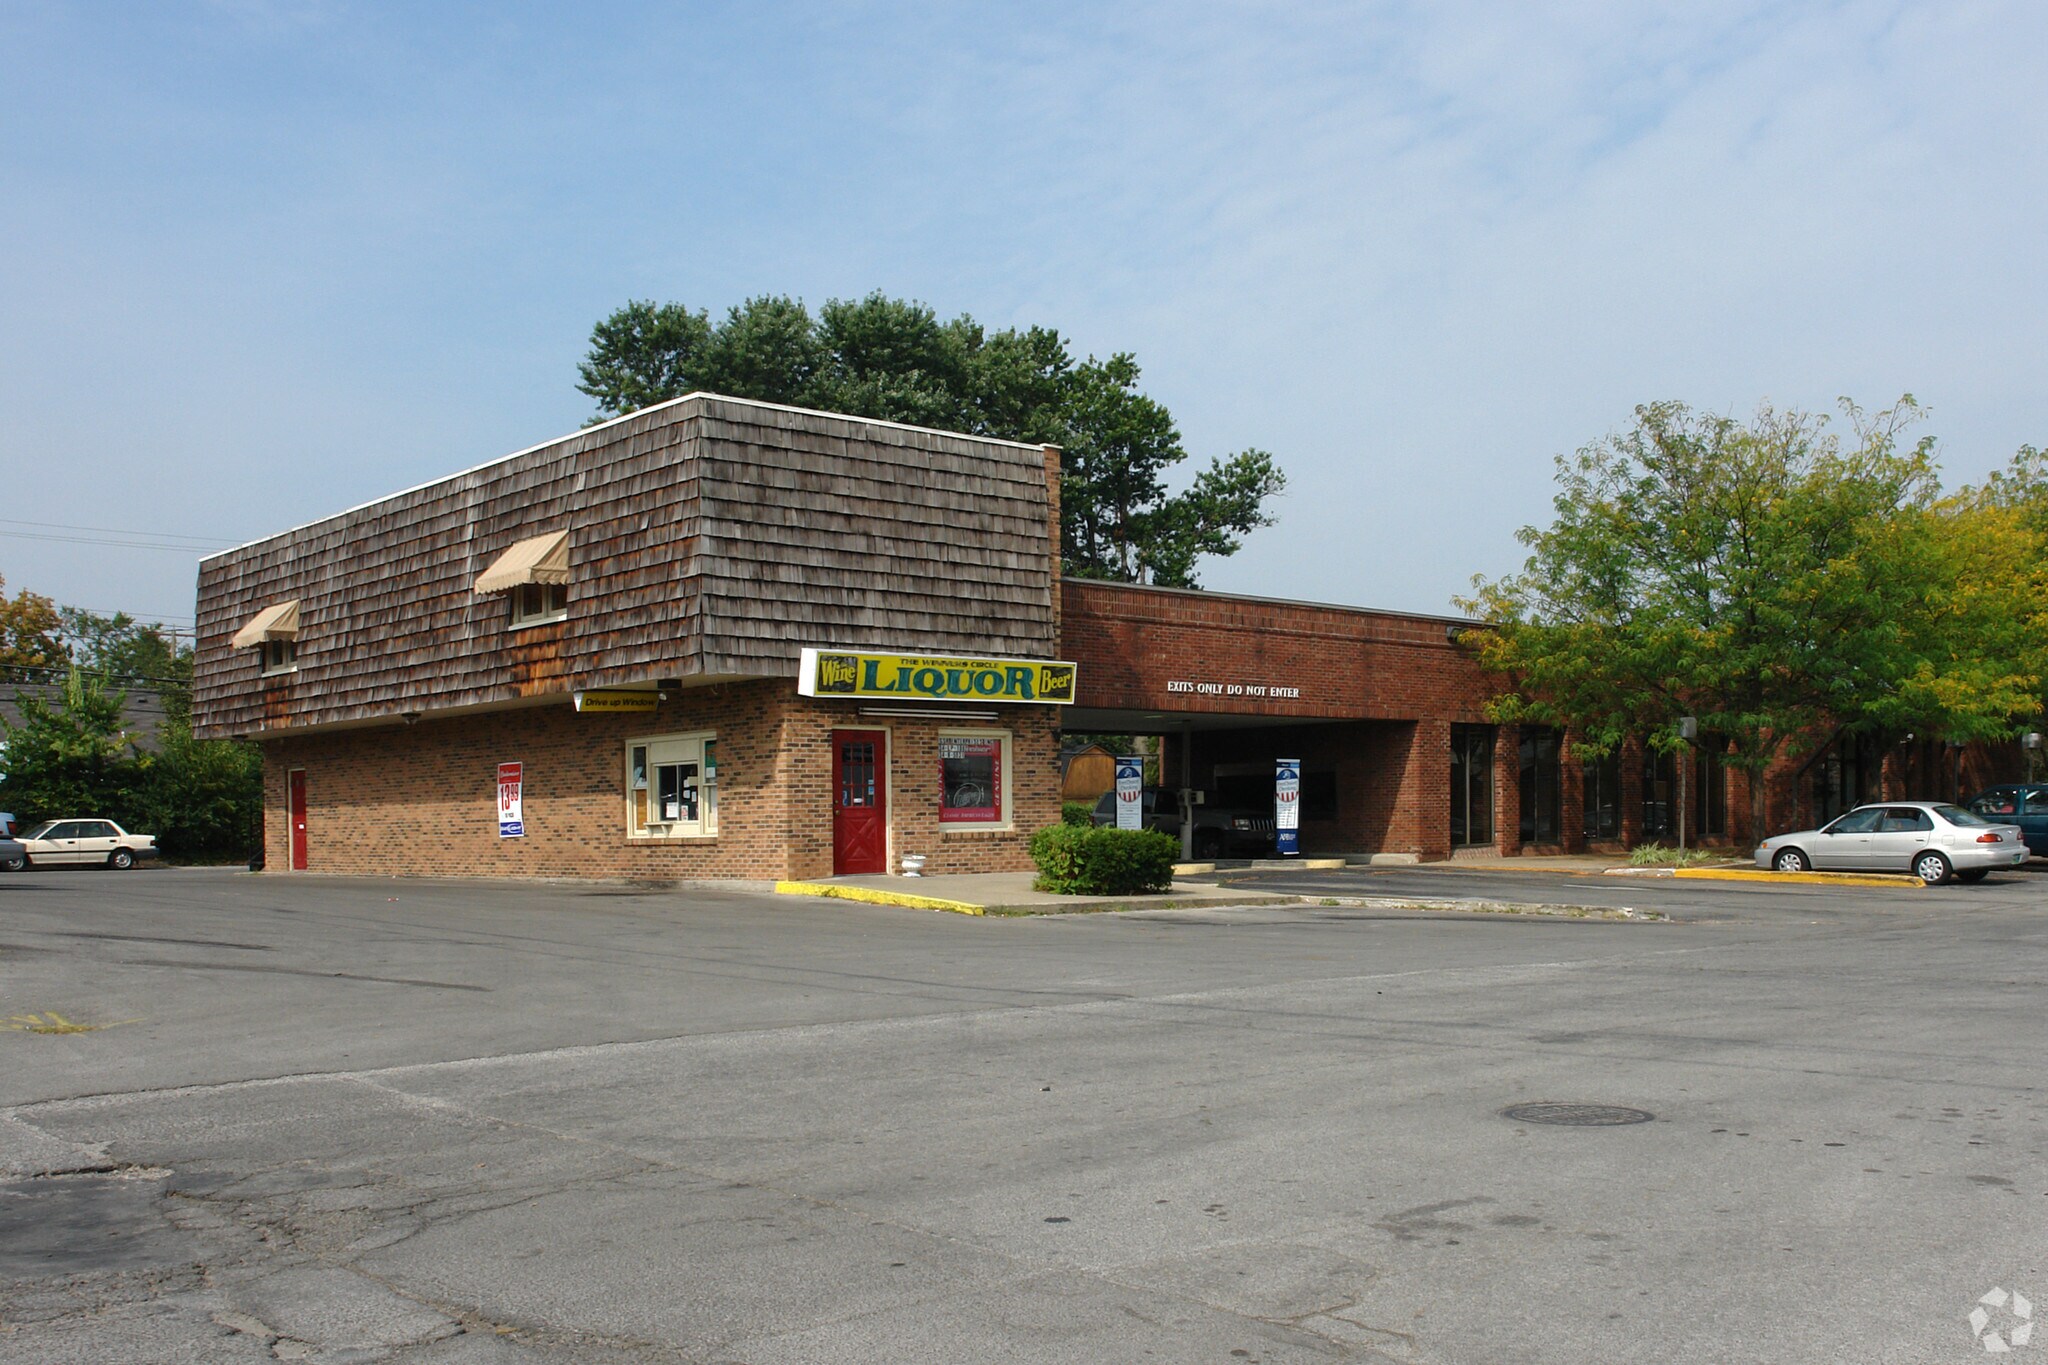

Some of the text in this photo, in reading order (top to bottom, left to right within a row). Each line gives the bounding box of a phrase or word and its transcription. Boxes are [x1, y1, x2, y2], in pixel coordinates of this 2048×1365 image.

[821, 660, 855, 686] Wine
[901, 658, 919, 666] THE
[970, 661, 999, 669] CIRCLE
[861, 659, 1035, 700] LIQUOR
[1040, 669, 1071, 693] Beer
[1167, 681, 1299, 698] EXITS ONLY DO NOT ENTER
[585, 698, 654, 707] Drive up Window
